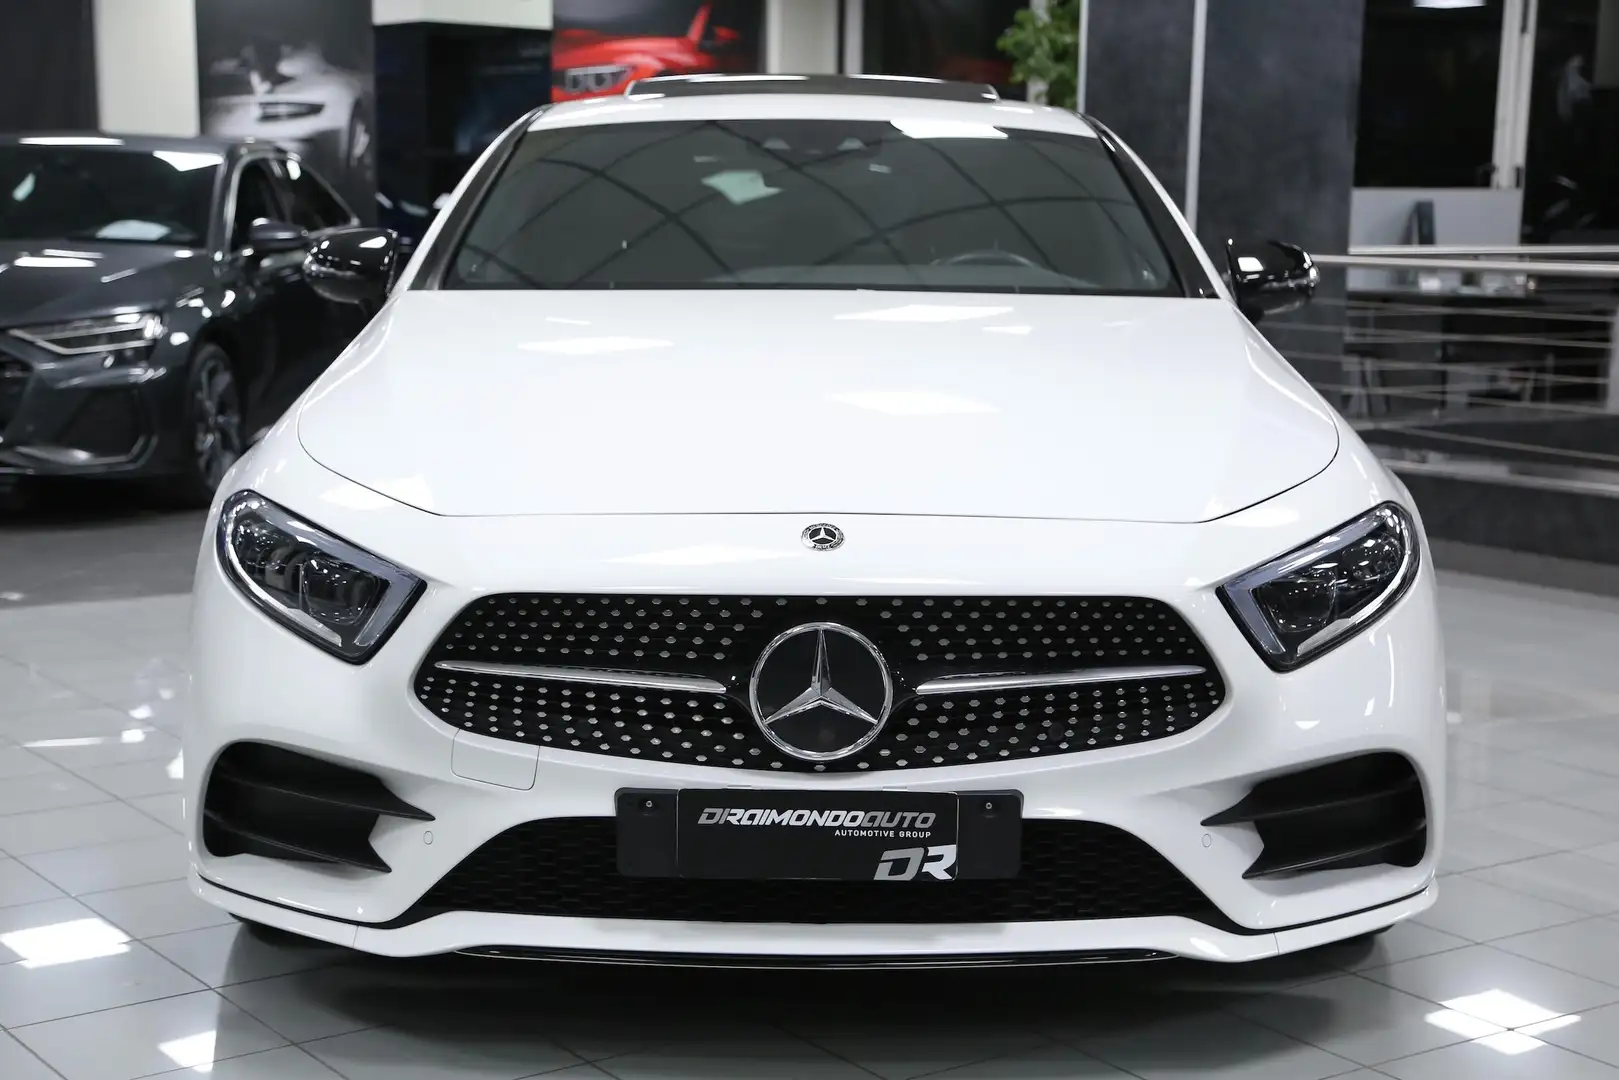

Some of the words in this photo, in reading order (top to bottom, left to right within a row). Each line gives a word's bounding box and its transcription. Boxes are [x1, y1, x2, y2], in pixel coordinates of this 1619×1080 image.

[834, 829, 895, 838] AUTOMOTIVE
[898, 830, 932, 839] GROUP
[874, 844, 957, 880] DR
